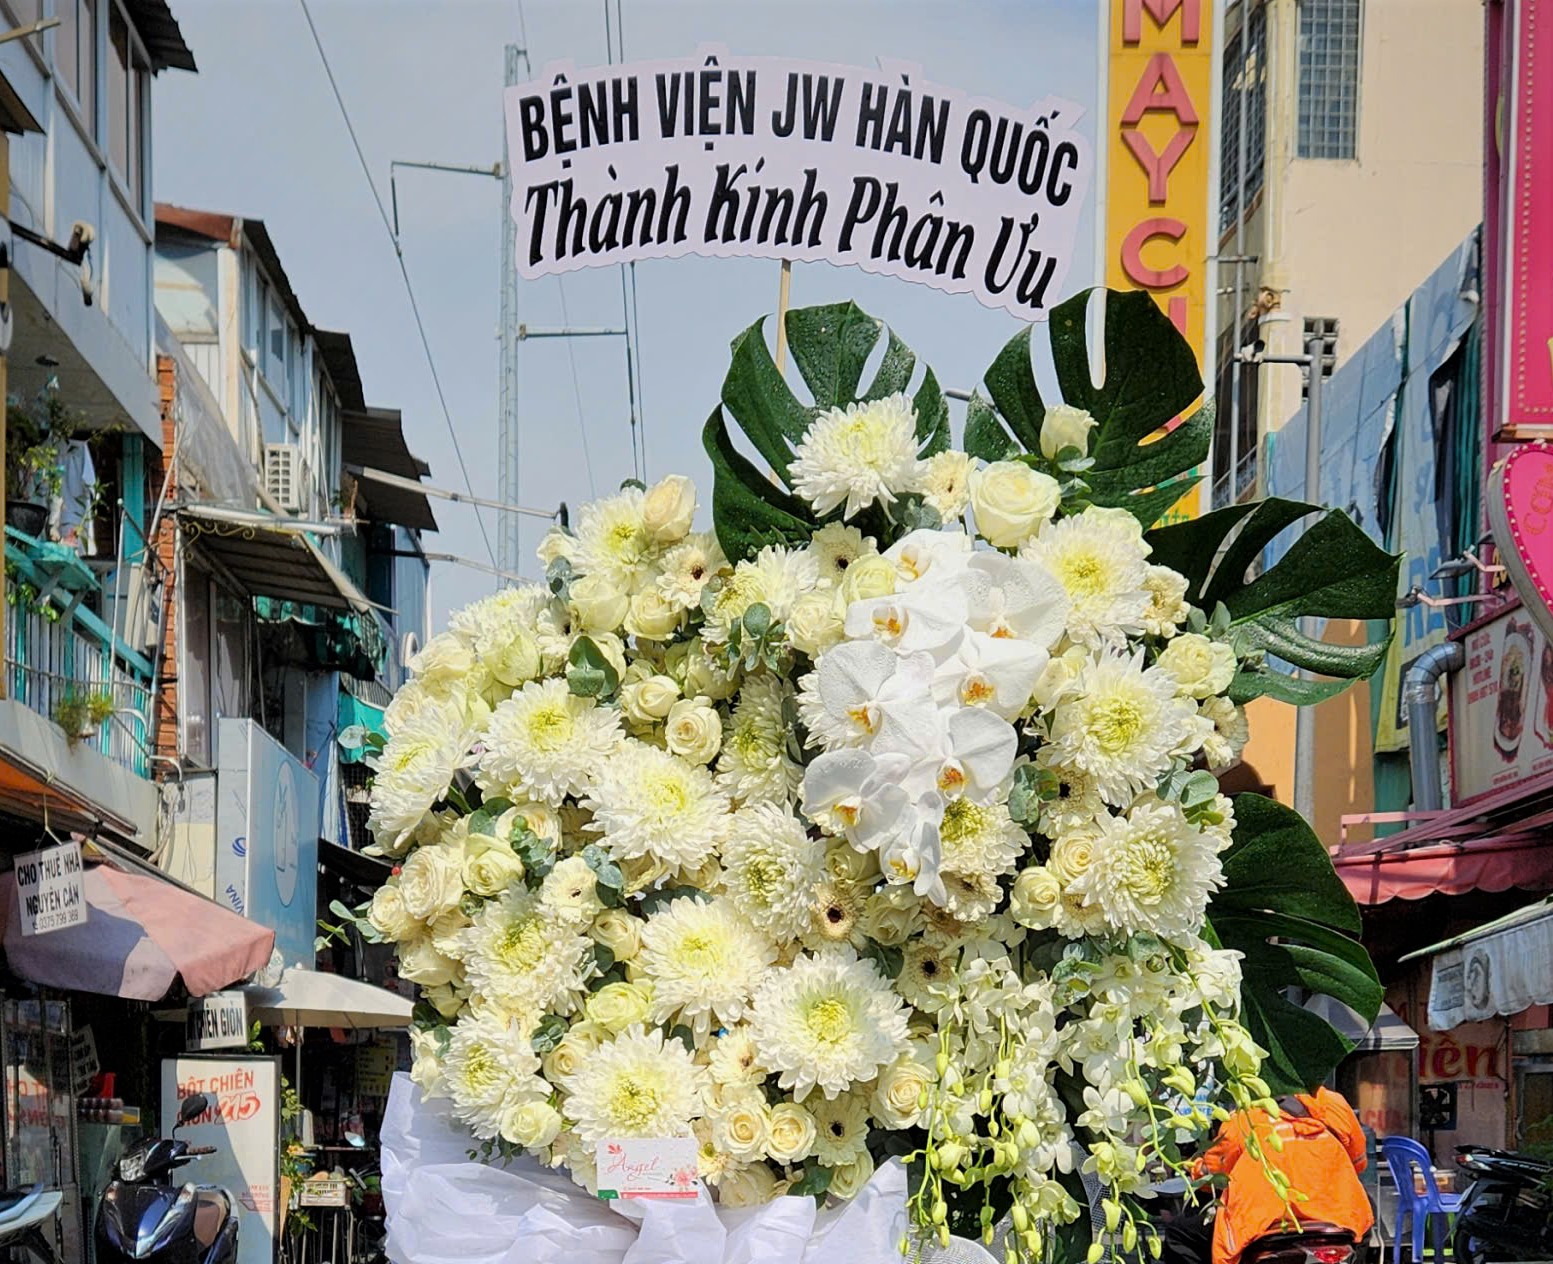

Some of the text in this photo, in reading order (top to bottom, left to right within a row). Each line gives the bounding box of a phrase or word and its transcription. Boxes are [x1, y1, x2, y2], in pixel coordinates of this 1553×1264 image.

[518, 56, 1079, 207] BỆNH VIỆN JW HÀN QUỐC
[524, 156, 1057, 309] Thành Kính Phân Ưu
[17, 846, 80, 886] CHO THUÊ NHÀ
[26, 887, 61, 917] NGUYÊN
[220, 1000, 243, 1037] GIÒN
[210, 1068, 254, 1095] CHIÊN
